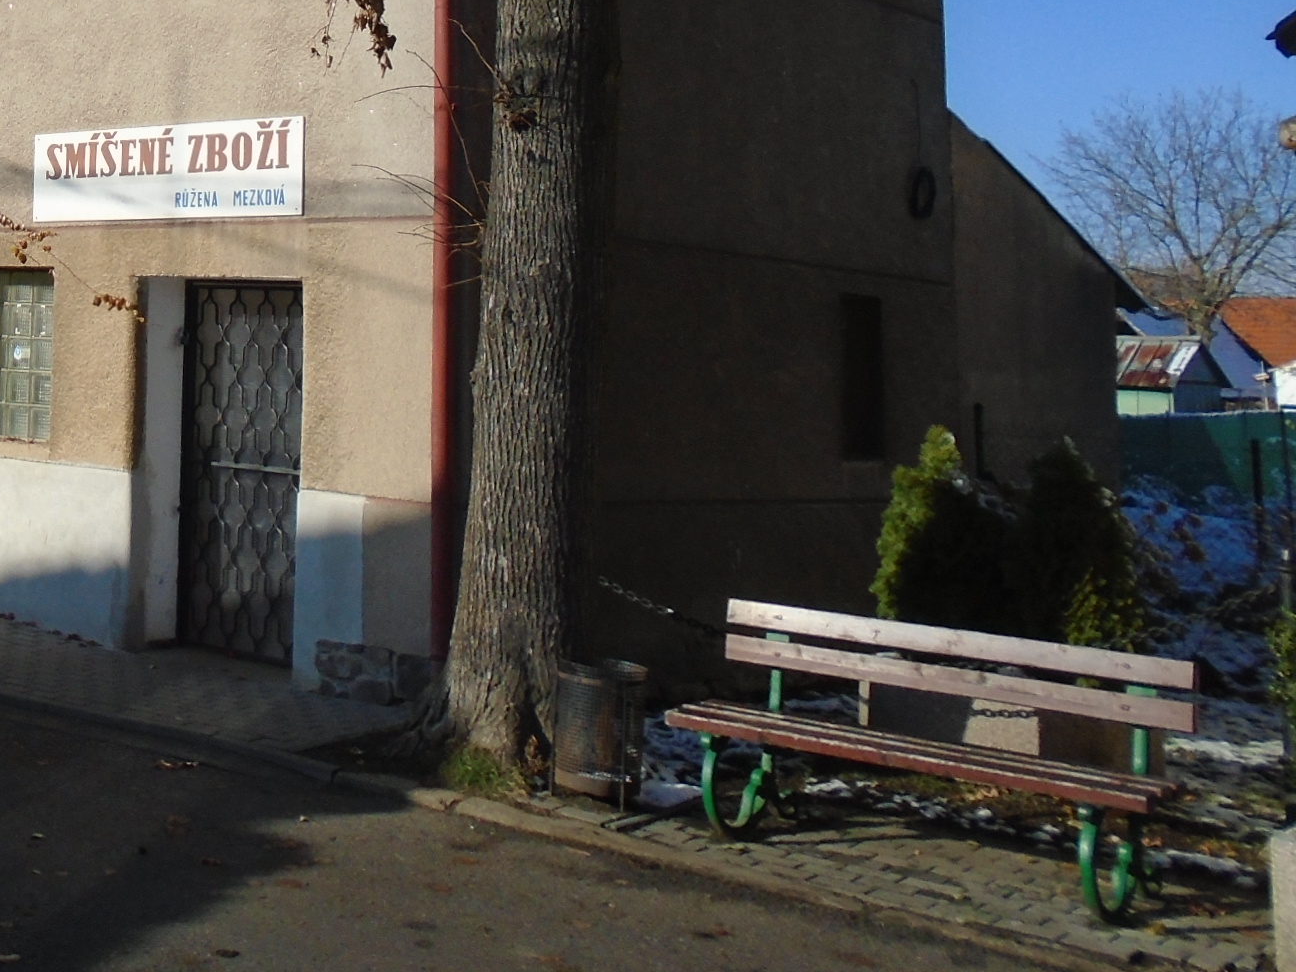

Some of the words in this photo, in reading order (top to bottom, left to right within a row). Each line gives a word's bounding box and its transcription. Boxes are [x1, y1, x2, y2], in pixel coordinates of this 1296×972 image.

[45, 128, 174, 180] SMÍŠENÉ
[187, 119, 292, 174] ZBOŽÍ
[233, 183, 285, 206] MEZKOVÁ
